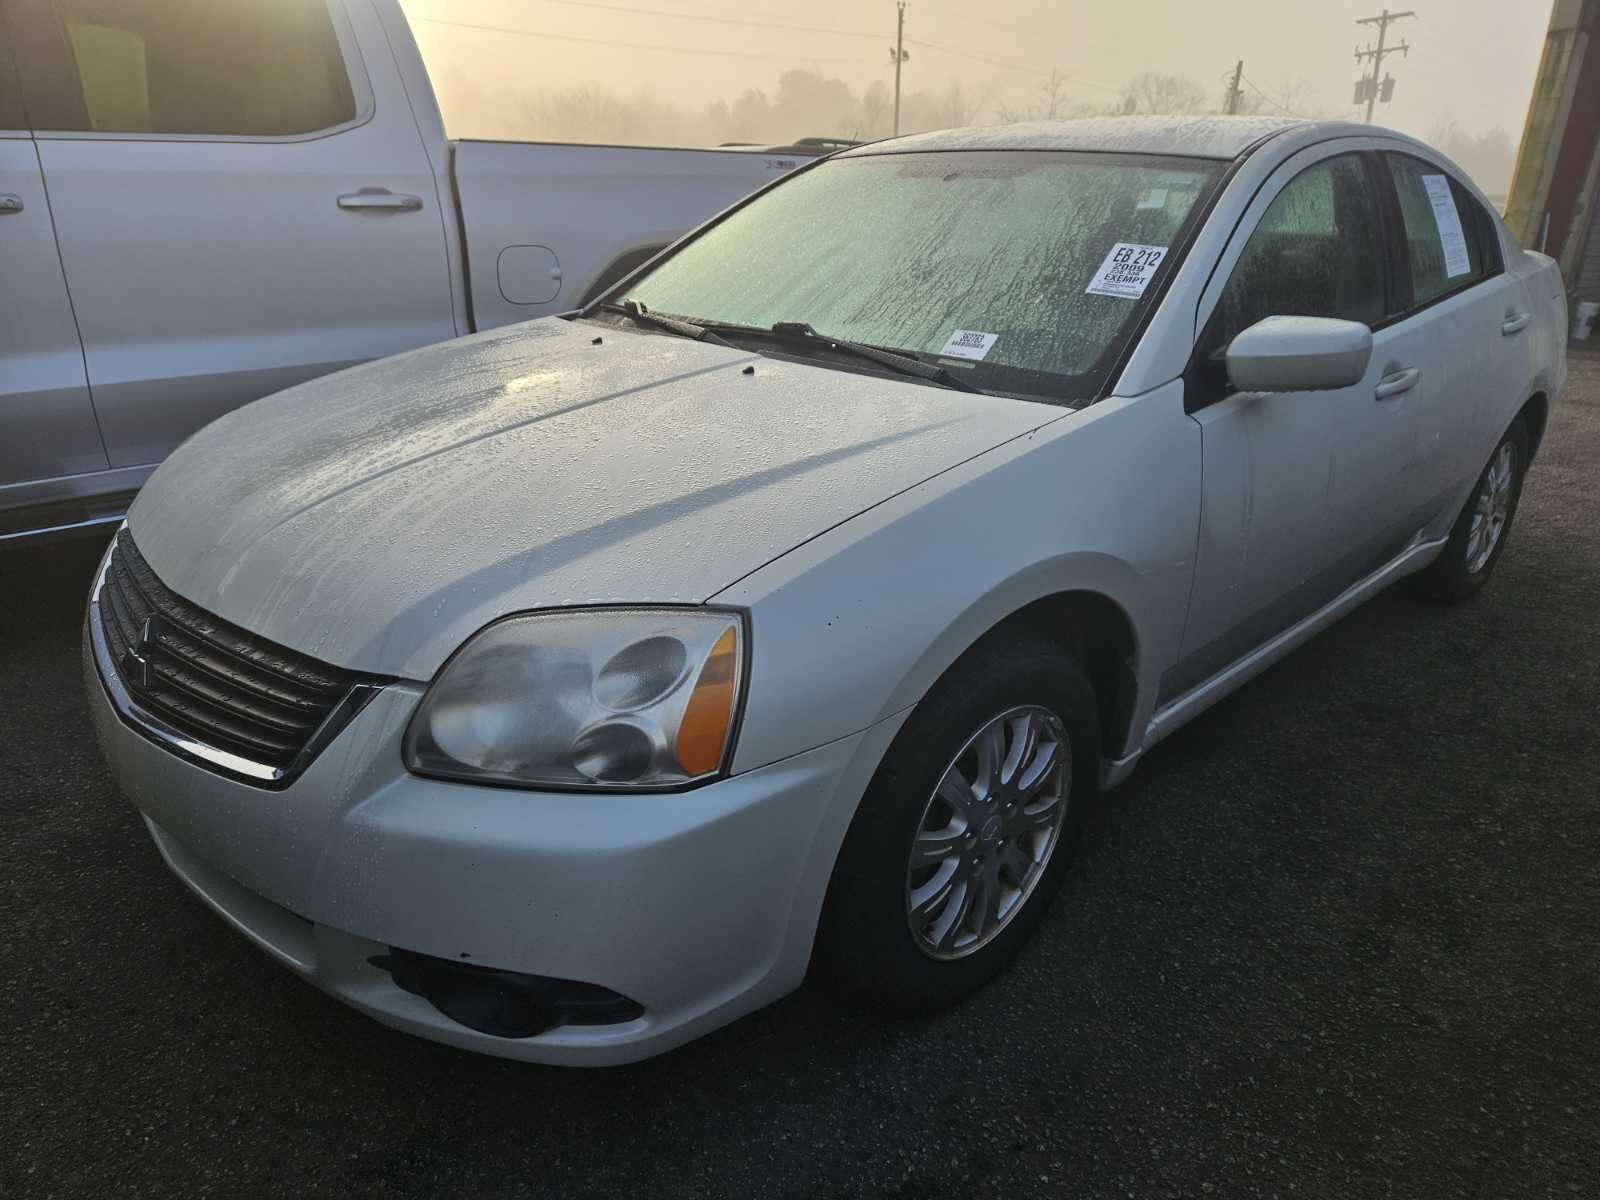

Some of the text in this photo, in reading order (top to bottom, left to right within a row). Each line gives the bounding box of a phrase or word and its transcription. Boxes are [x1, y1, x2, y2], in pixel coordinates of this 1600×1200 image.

[1113, 247, 1162, 266] EB 212
[1112, 262, 1145, 272] 2009
[1103, 273, 1146, 285] EXEMPT
